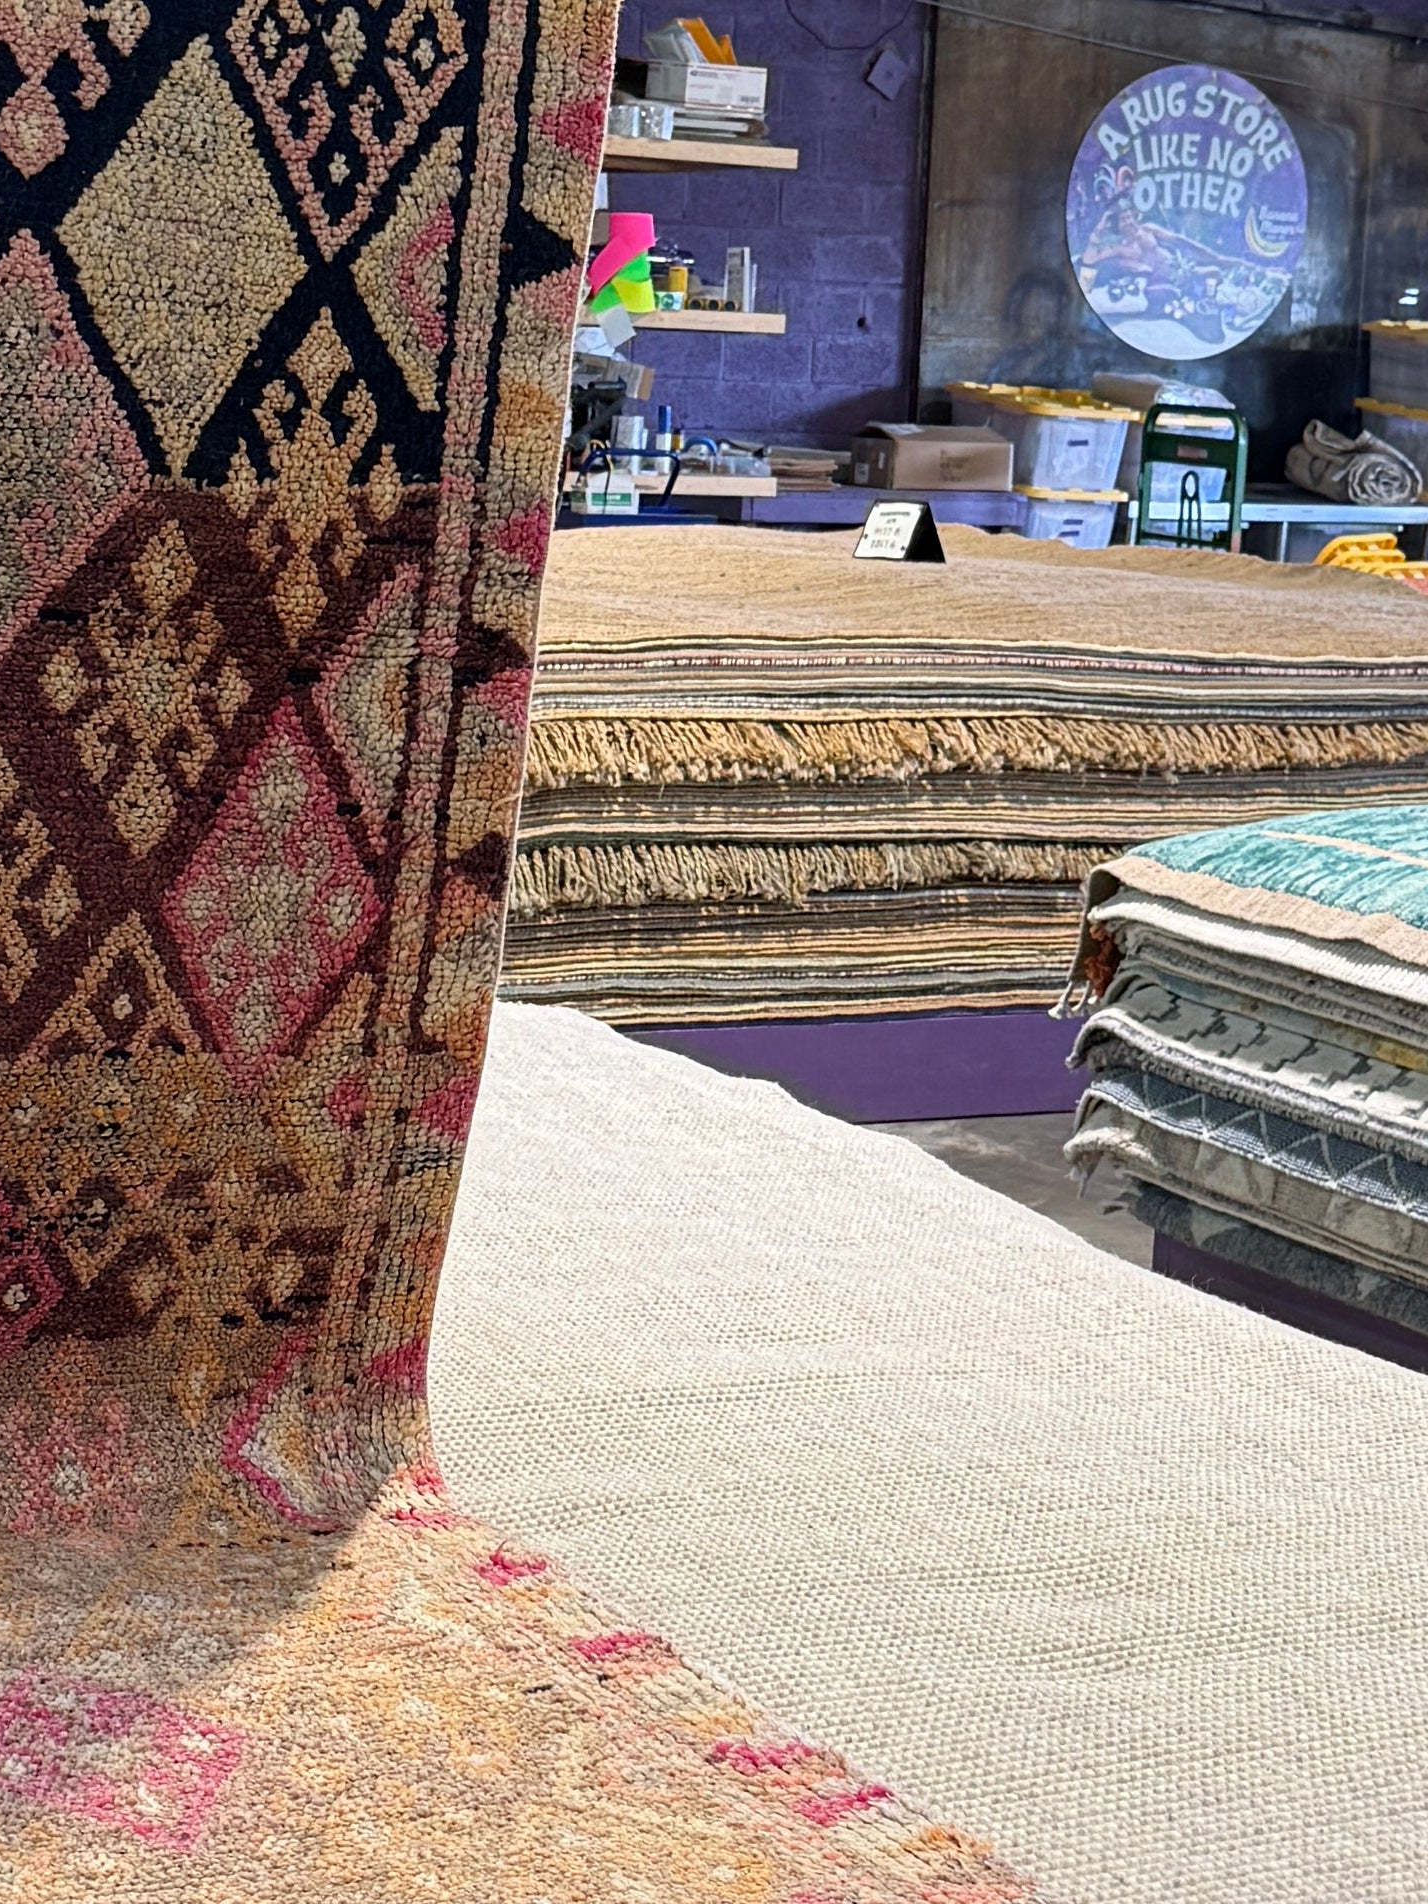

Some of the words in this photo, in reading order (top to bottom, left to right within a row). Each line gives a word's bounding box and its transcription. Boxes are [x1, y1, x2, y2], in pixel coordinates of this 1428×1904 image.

[1097, 124, 1130, 161] A
[1121, 82, 1186, 135] RUG
[1193, 84, 1293, 172] STORE
[1133, 133, 1201, 172] LIKE
[1206, 135, 1255, 179] NO
[1132, 171, 1246, 219] OTHER
